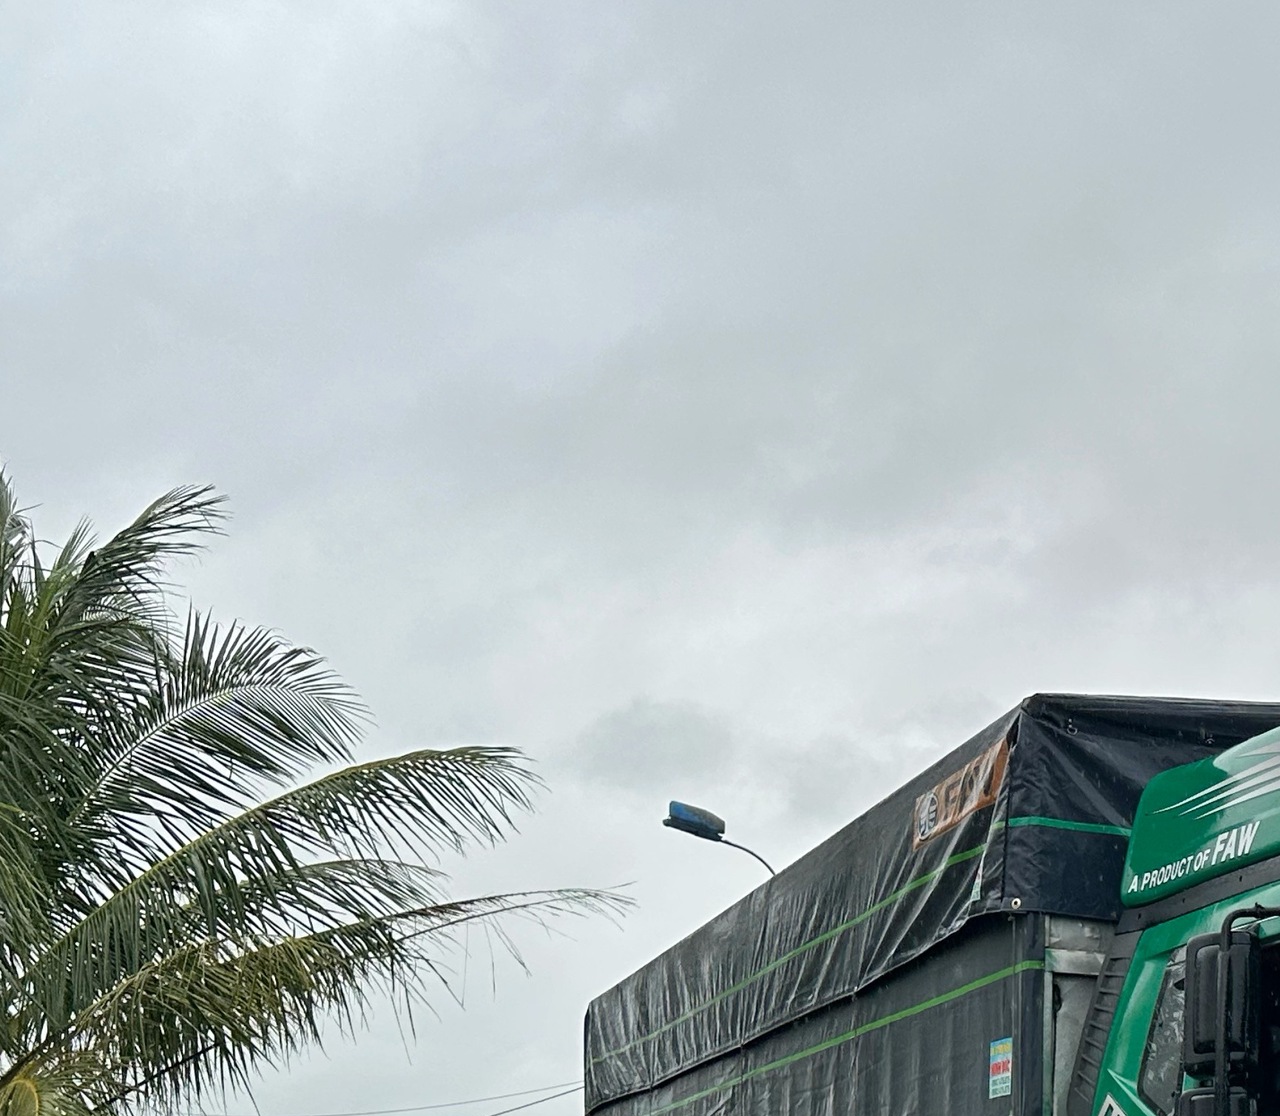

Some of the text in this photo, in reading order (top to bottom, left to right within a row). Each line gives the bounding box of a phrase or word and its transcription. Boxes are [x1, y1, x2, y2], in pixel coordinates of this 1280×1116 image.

[1128, 820, 1260, 893] A PRODUCT OF FAW
